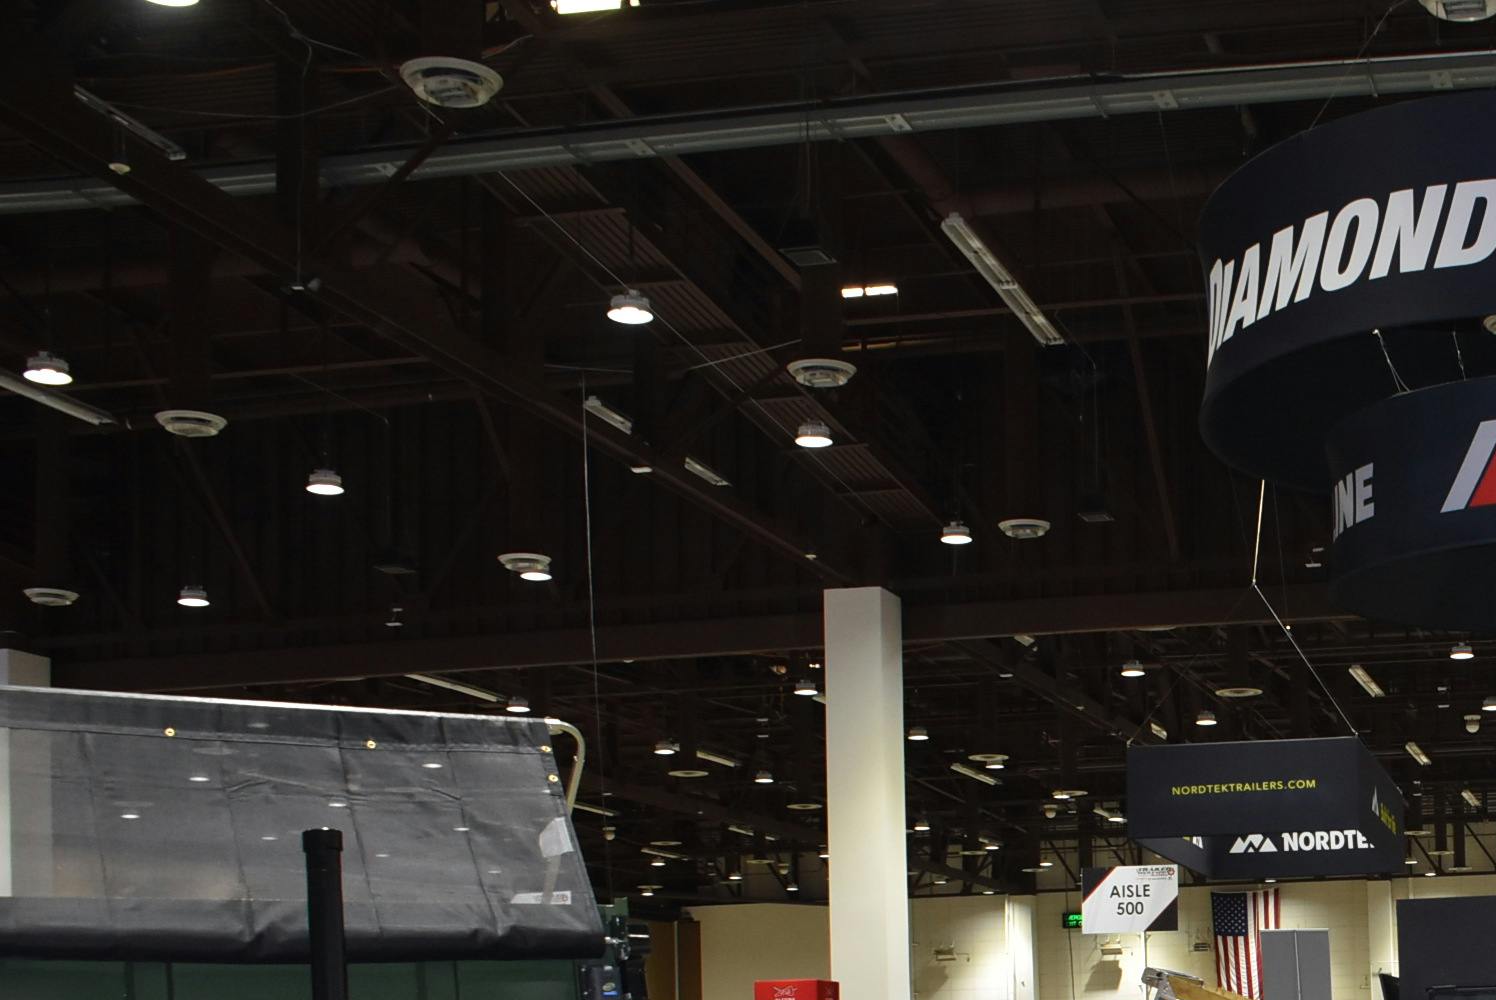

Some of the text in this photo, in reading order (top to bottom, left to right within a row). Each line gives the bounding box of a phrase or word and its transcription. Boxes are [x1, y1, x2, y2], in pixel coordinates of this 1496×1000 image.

[1171, 779, 1316, 796] NORDTEKTRAILERS.COM
[1110, 884, 1151, 898] AISLE
[1116, 902, 1144, 915] 500
